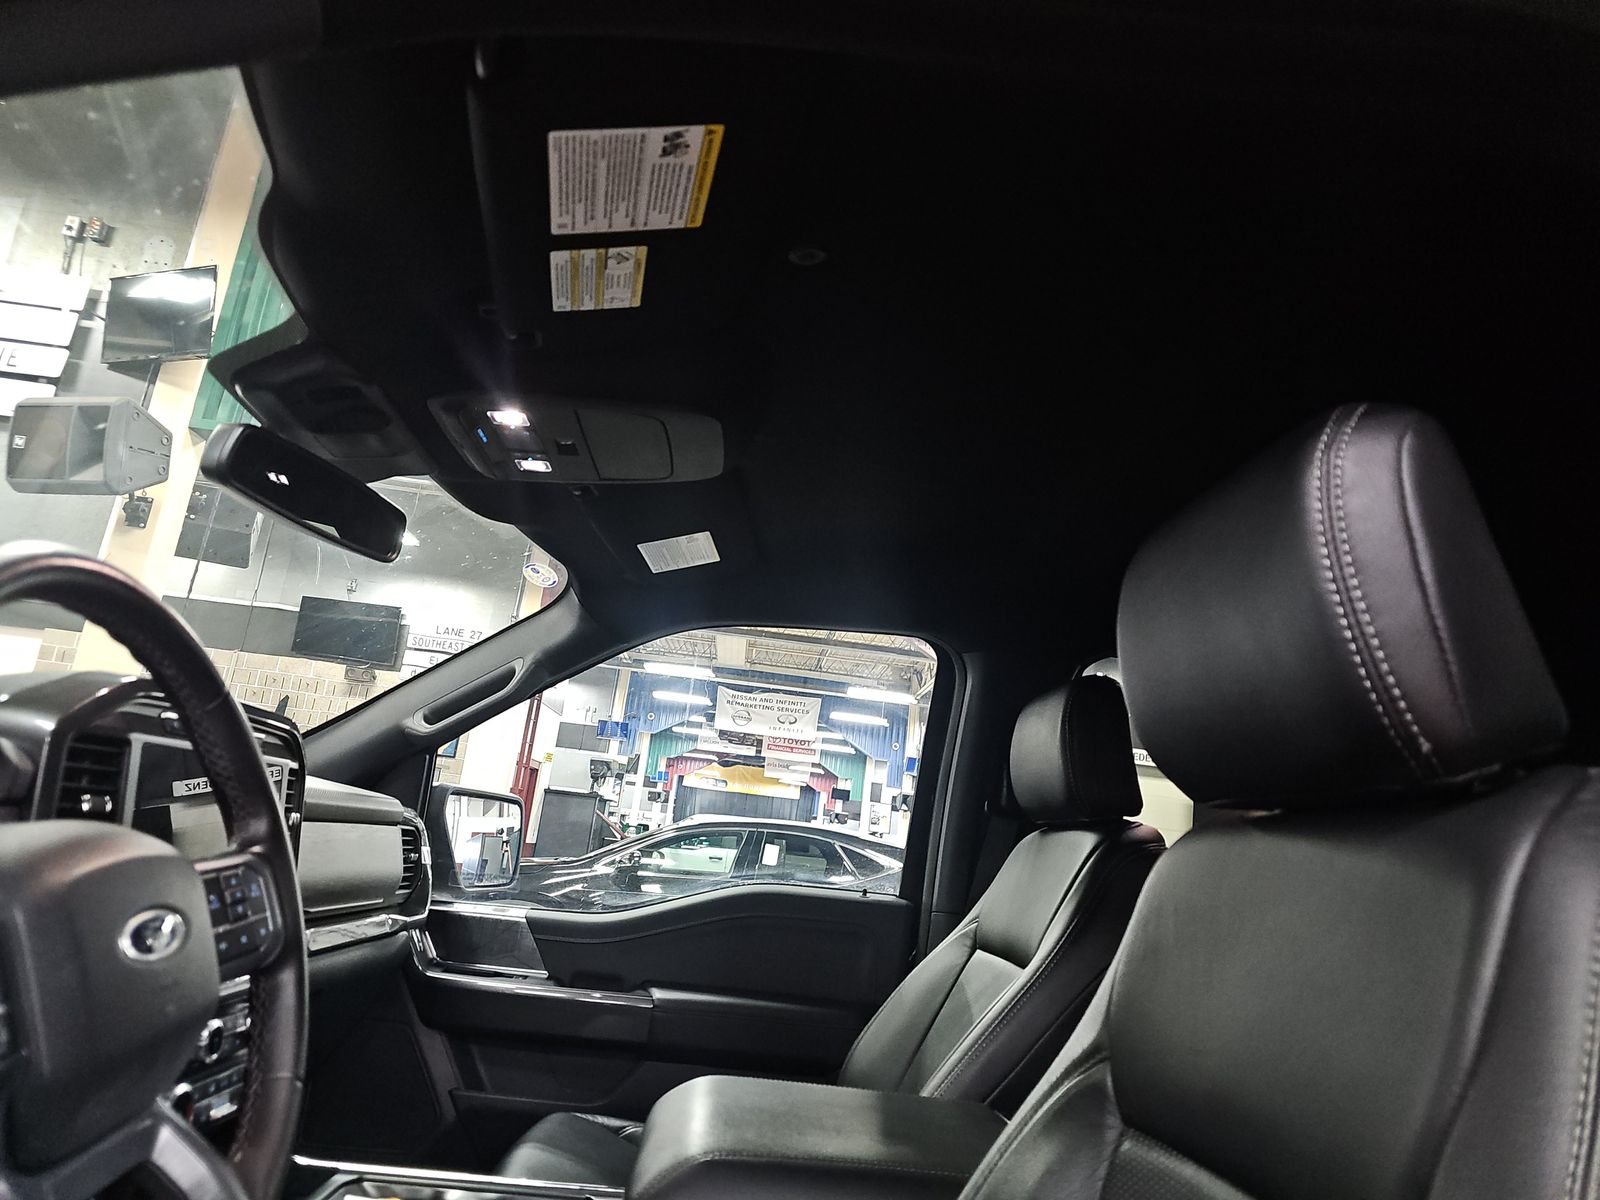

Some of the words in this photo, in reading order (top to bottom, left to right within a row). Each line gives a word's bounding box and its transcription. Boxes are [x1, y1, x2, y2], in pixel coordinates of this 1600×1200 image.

[436, 625, 464, 637] LANE
[470, 630, 483, 640] 27
[412, 637, 465, 652] SOUTHEAST
[726, 699, 775, 711] REMARKETING
[731, 694, 757, 702] NISSAN
[759, 696, 774, 704] AND
[775, 699, 806, 707] INFINITI
